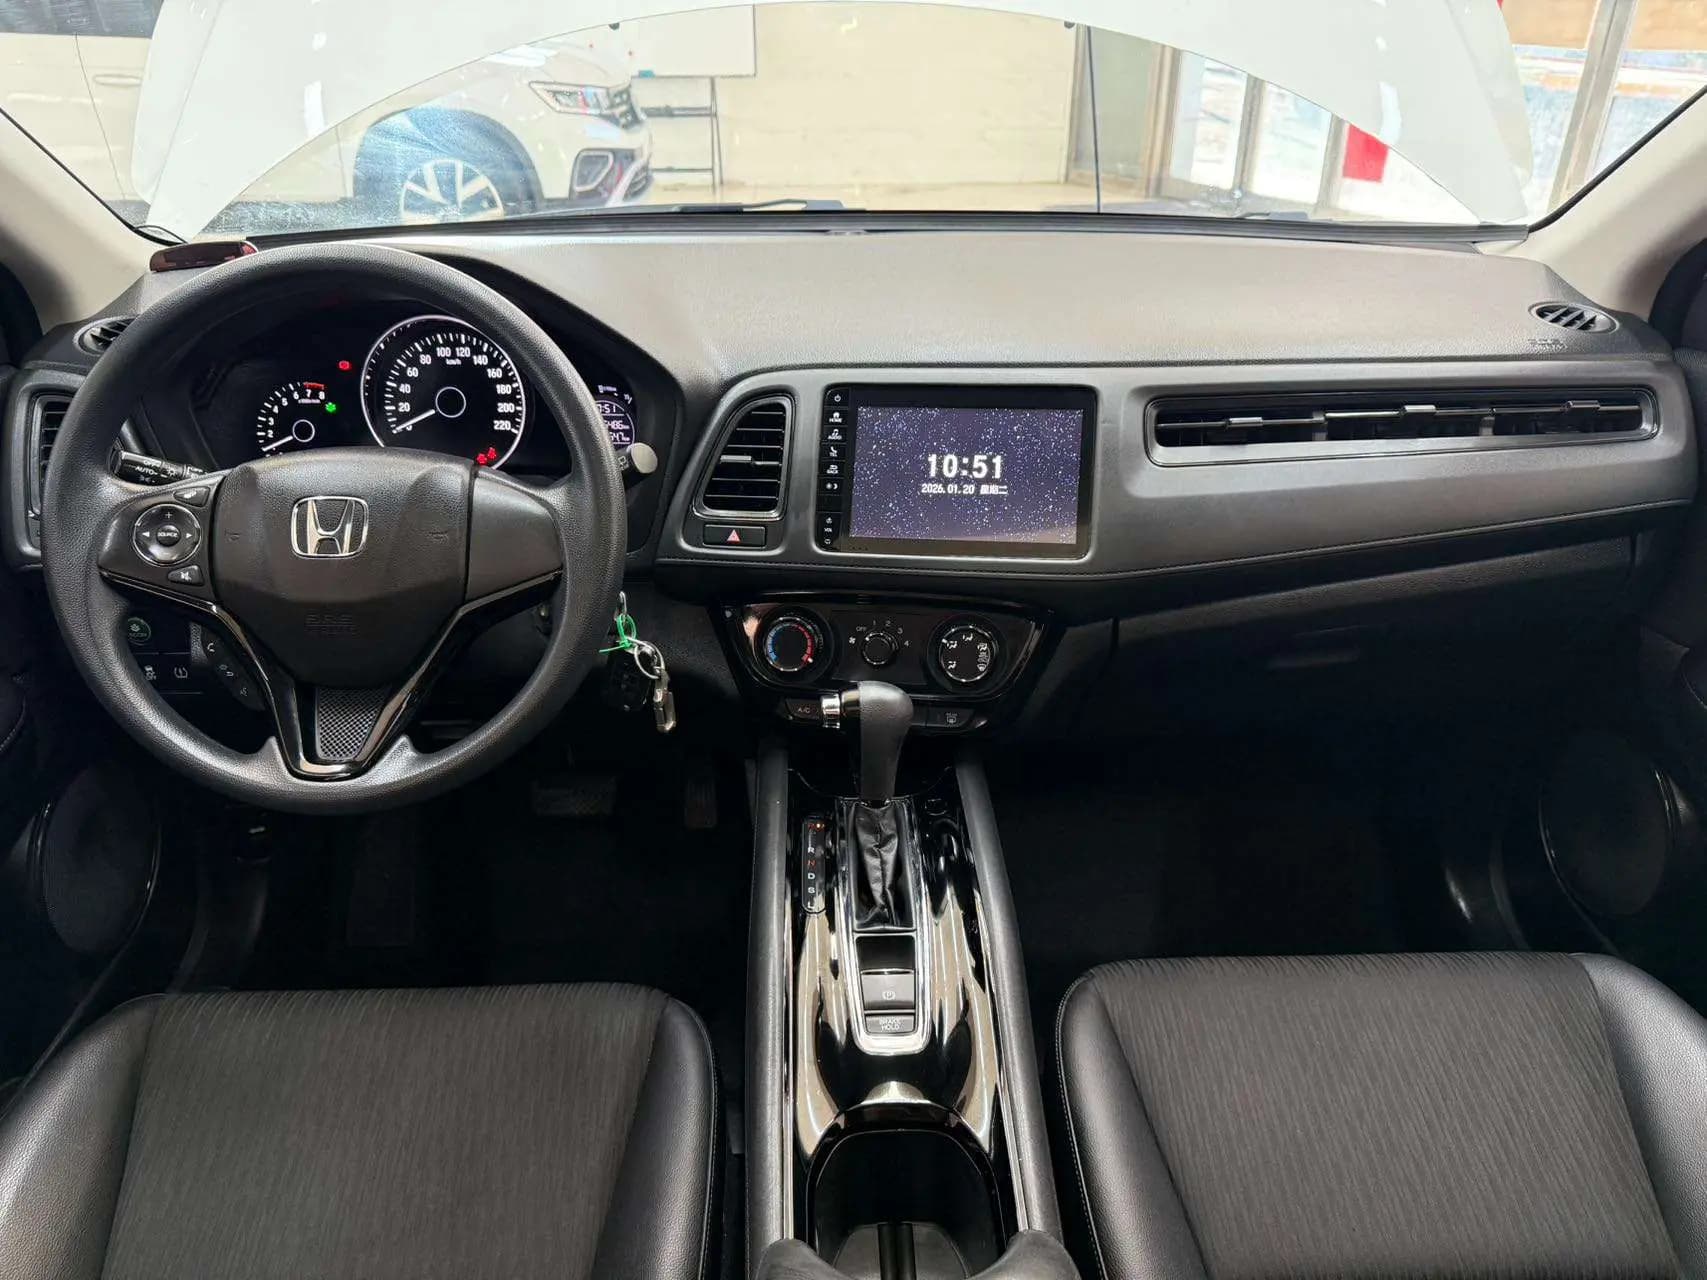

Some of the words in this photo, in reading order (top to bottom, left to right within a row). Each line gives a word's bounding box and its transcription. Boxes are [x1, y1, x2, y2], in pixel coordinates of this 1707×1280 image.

[436, 347, 451, 357] 100
[455, 347, 471, 357] 120
[420, 354, 431, 365] 80
[473, 355, 488, 365] 140
[406, 367, 419, 377] 60
[487, 368, 502, 378] 160
[399, 383, 411, 393] 40
[496, 384, 511, 394] 180
[293, 391, 299, 400] 6
[306, 389, 311, 398] 7
[281, 397, 288, 406] 5
[398, 402, 410, 412] 20
[497, 403, 515, 413] 200
[268, 417, 274, 426] 3
[493, 420, 511, 430] 220
[267, 429, 274, 438] 2
[928, 453, 1002, 479] 10:51
[921, 483, 975, 495] 2026.01.20
